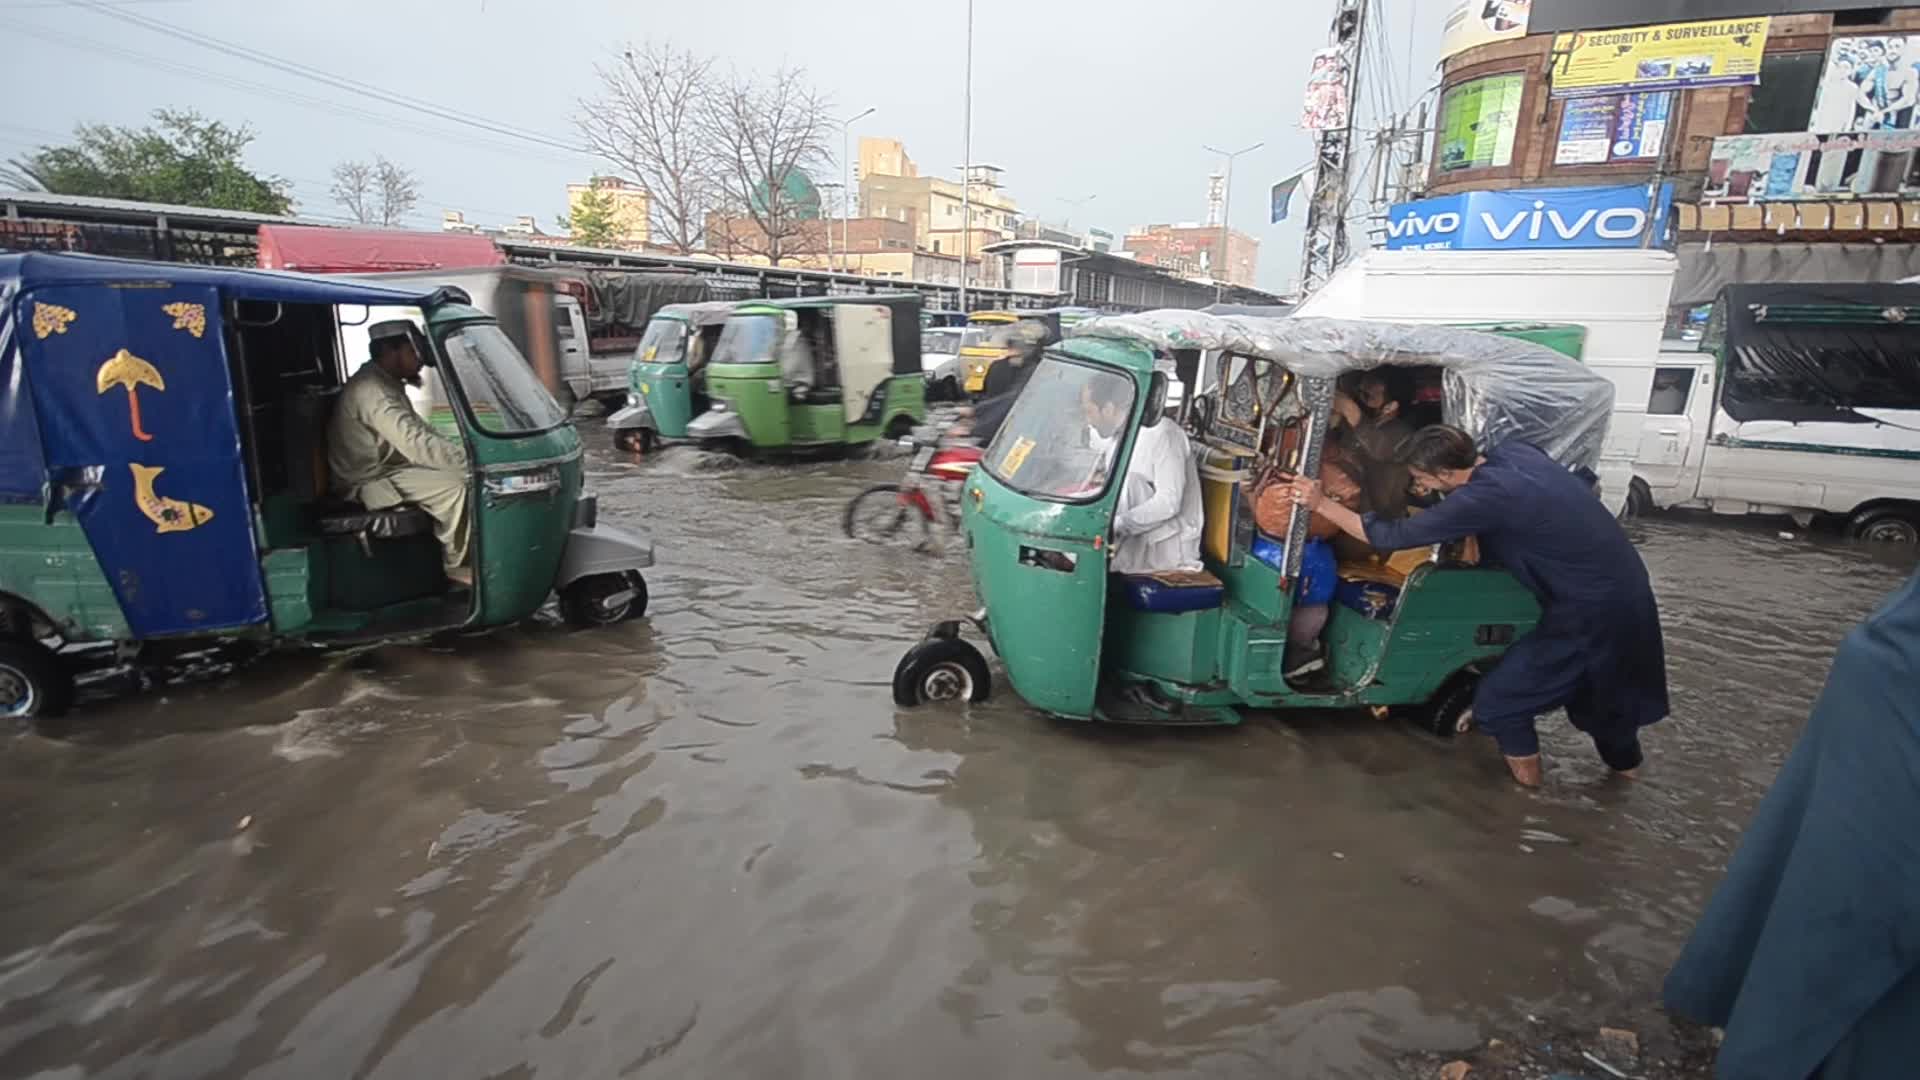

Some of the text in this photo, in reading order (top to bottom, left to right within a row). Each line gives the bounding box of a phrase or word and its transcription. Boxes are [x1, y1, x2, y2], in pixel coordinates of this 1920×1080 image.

[1652, 29, 1661, 41] &
[1665, 21, 1762, 40] SURVEILLANCE
[1386, 211, 1459, 238] vivo
[1480, 200, 1646, 240] vivo
